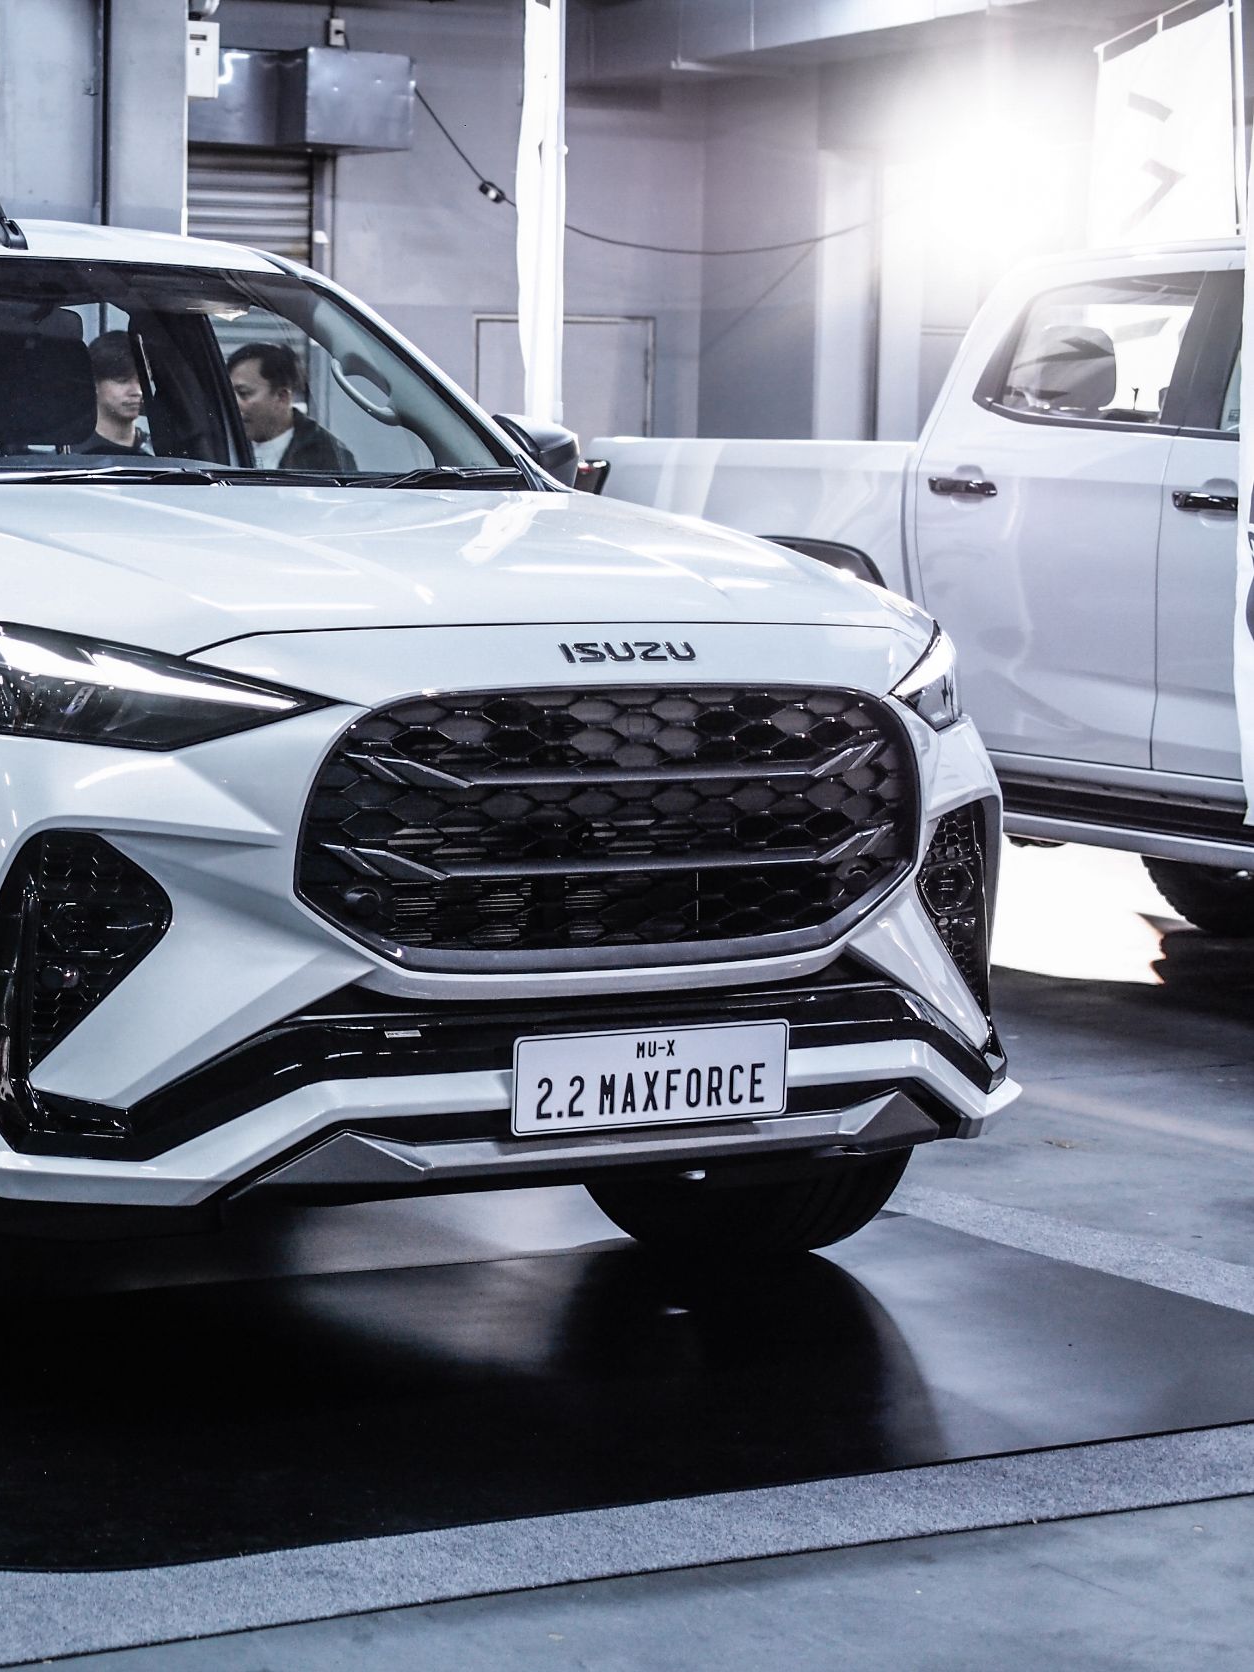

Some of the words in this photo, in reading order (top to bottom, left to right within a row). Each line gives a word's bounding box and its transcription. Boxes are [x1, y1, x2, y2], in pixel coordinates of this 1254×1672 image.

[557, 642, 697, 663] ISUZU
[636, 1040, 676, 1058] MU-X
[536, 1075, 585, 1120] 2.2
[598, 1062, 766, 1116] MAXFORCE
